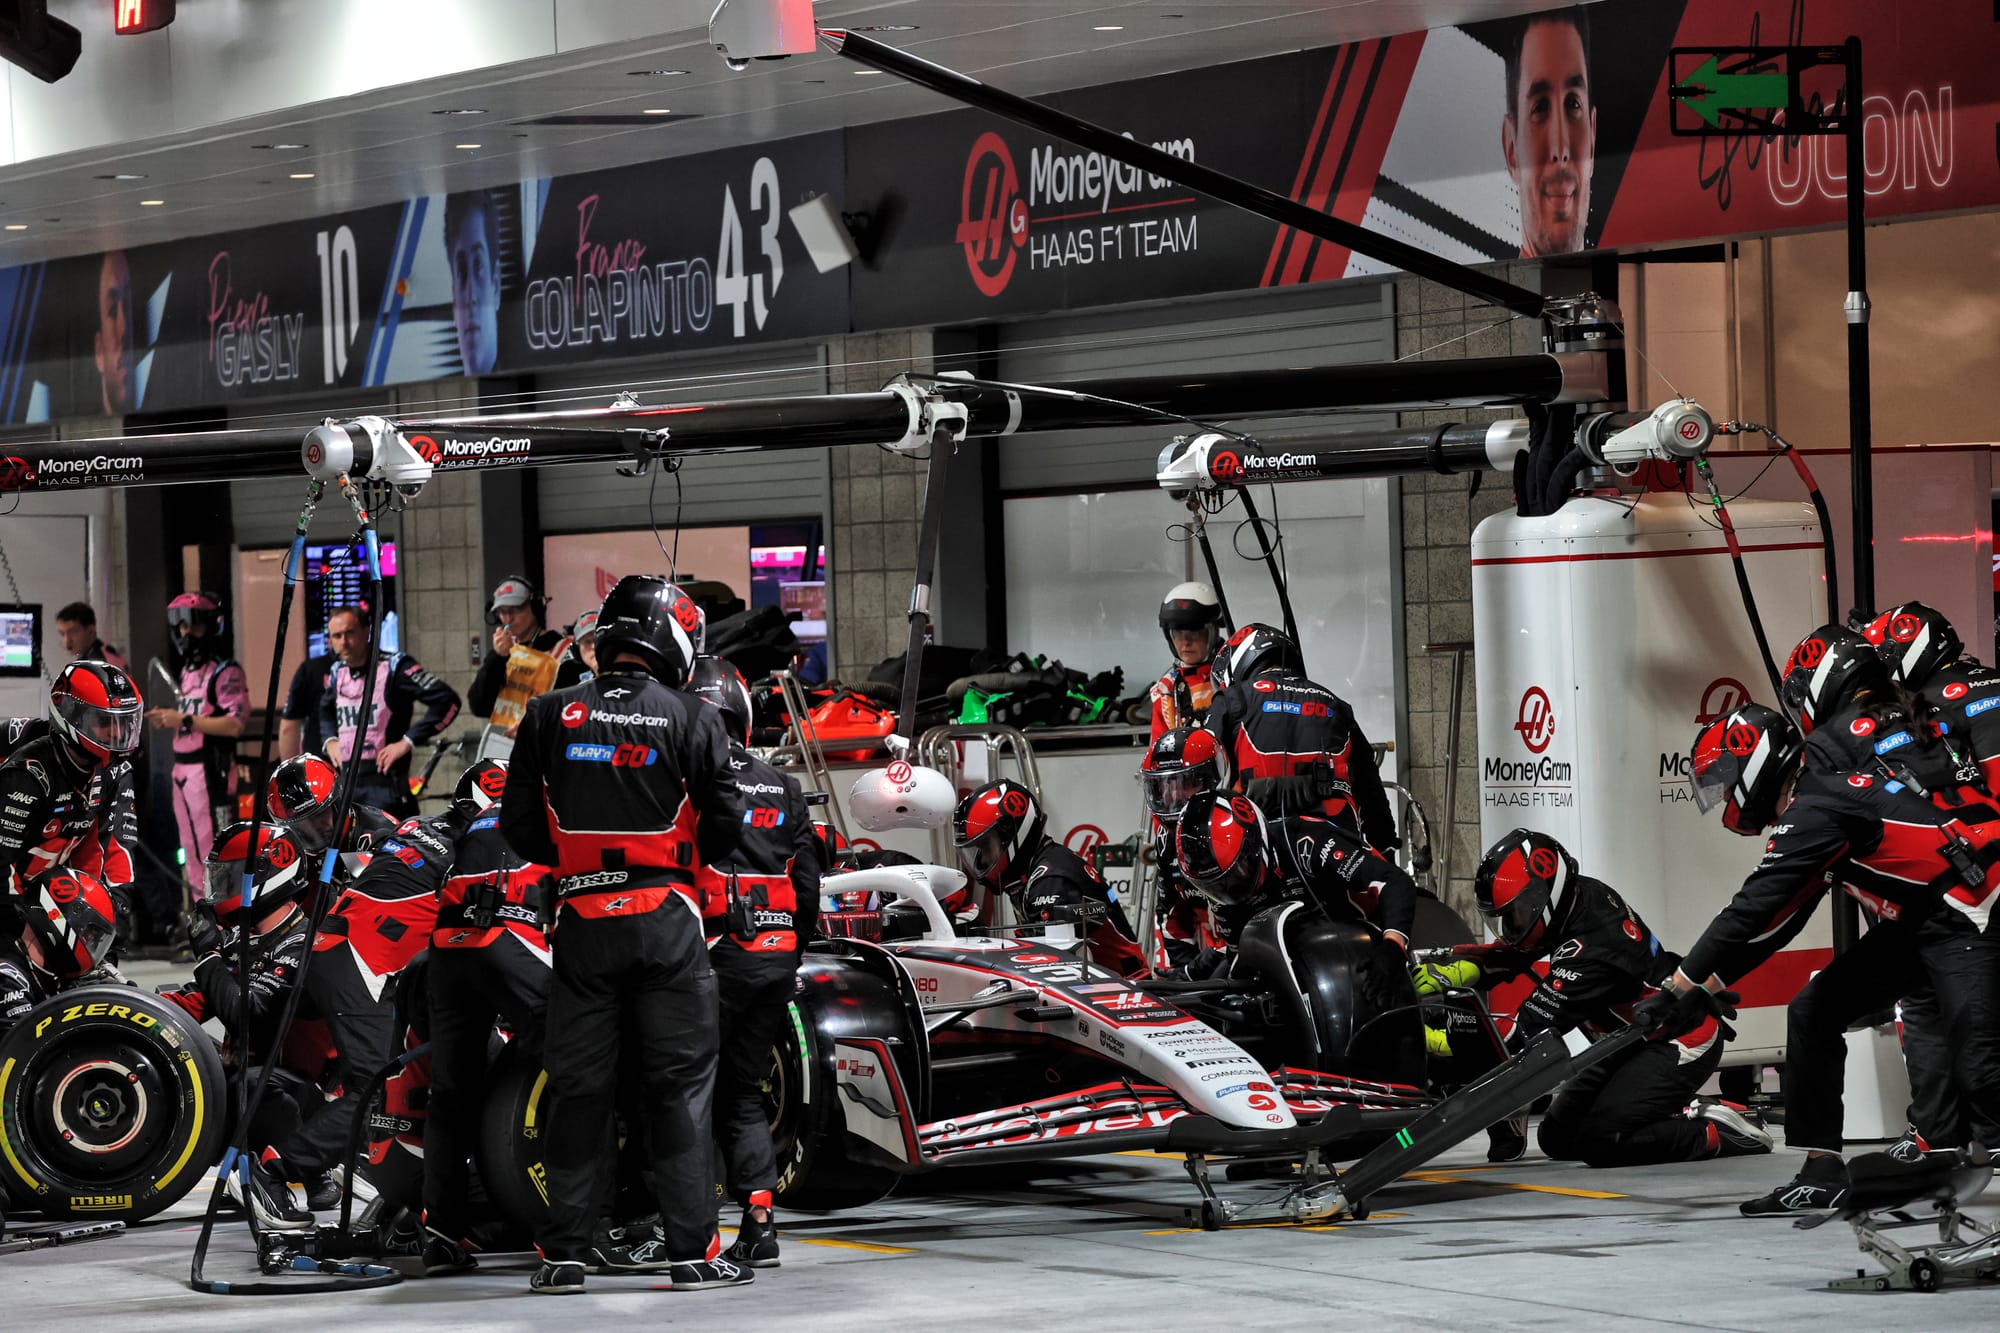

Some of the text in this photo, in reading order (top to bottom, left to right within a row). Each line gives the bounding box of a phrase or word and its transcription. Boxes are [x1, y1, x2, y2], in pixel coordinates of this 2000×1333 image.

[576, 194, 646, 307] Franco
[716, 157, 784, 337] 43
[1030, 215, 1197, 270] HAAS F1 TEAM
[317, 225, 360, 384] 10
[525, 257, 712, 349] COLAPINTO
[216, 313, 303, 387] GASLY
[443, 437, 531, 457] MoneyGram
[38, 456, 143, 474] MoneyGram
[440, 459, 475, 468] HAAS
[493, 456, 529, 465] TEAM
[1243, 452, 1317, 471] MoneyGram
[38, 473, 144, 486] HAAS F1 TEAM
[590, 709, 668, 728] MoneyGram
[1301, 701, 1327, 717] GO
[611, 743, 650, 768] GO
[1484, 756, 1571, 787] MoneyGram
[735, 780, 784, 796] neyGram
[7, 791, 38, 805] HAAS
[1485, 792, 1573, 807] HAAS F1 TEAM
[752, 807, 779, 829] GO
[1772, 824, 1795, 835] AAS
[1032, 894, 1060, 907] HAAS
[1028, 964, 1111, 983] 31
[1551, 967, 1583, 981] HAAS
[35, 1003, 158, 1039] P ZERO
[1452, 1011, 1477, 1026] Mphasis
[1144, 1028, 1212, 1039] ZOOMEX
[776, 1161, 796, 1194] ZE
[70, 1194, 132, 1211] PIRELLI
